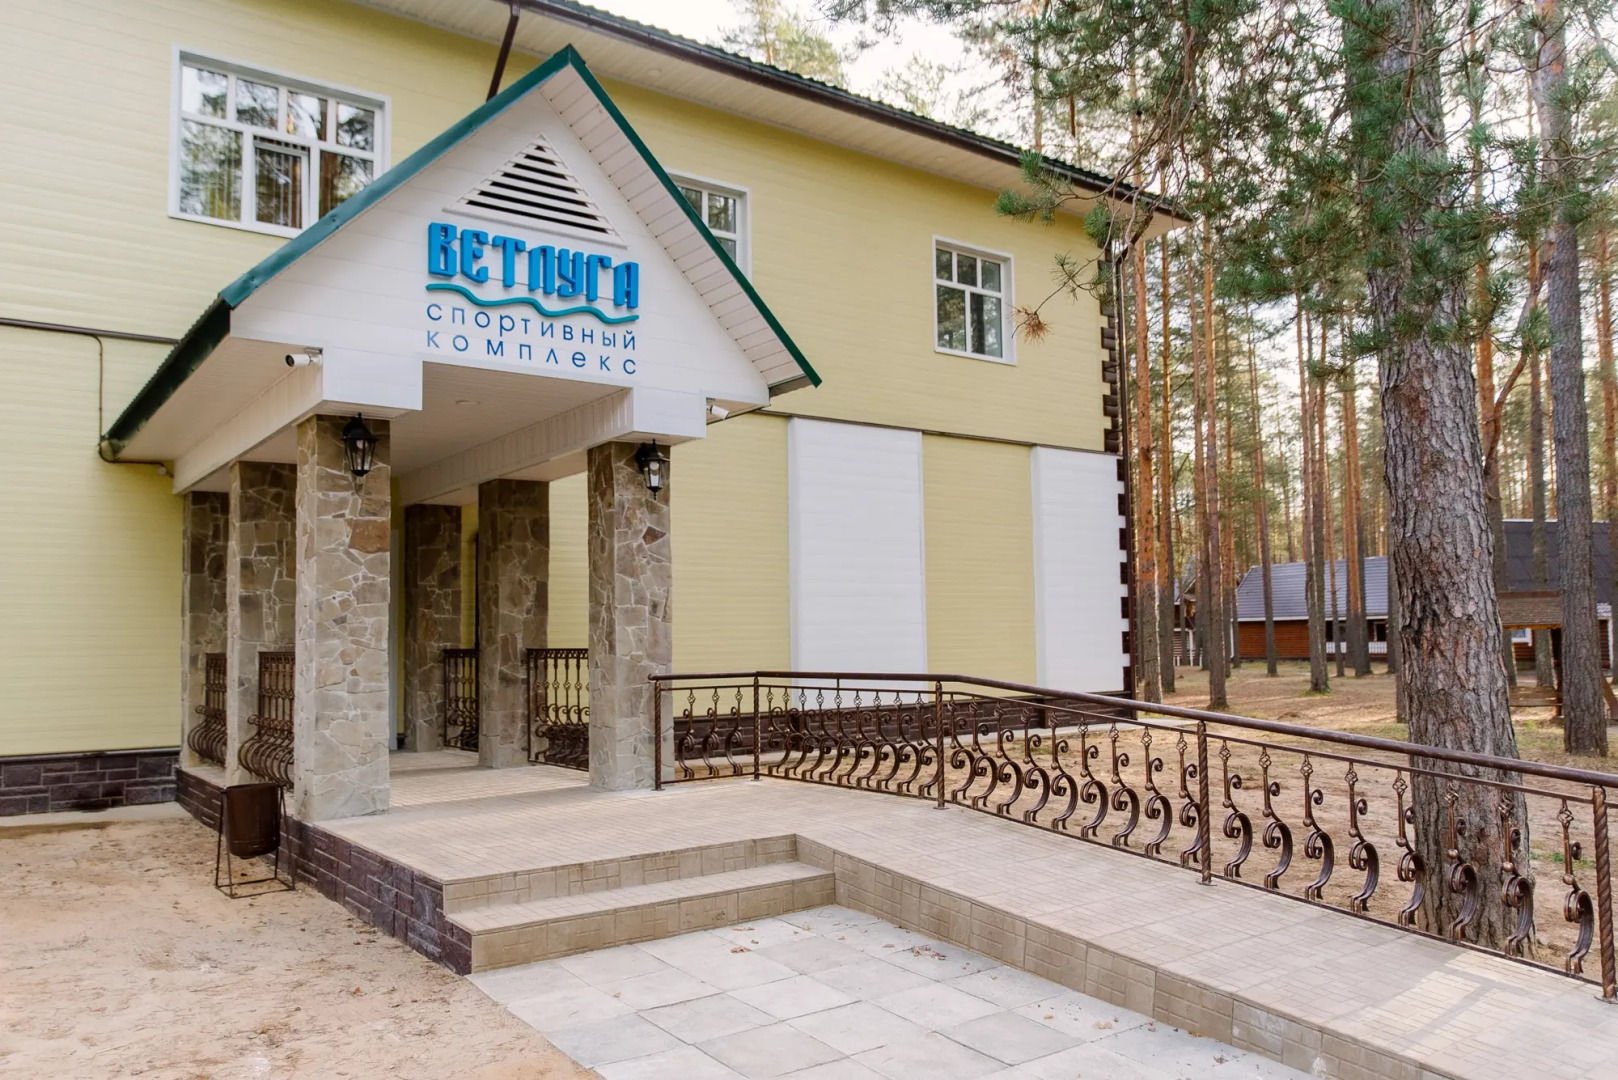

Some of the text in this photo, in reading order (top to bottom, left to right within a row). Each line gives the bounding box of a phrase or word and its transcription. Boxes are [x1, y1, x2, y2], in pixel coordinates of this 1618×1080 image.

[428, 222, 639, 309] ВЕТЛУГА
[427, 304, 635, 350] спортивный
[427, 331, 636, 374] комплекс
